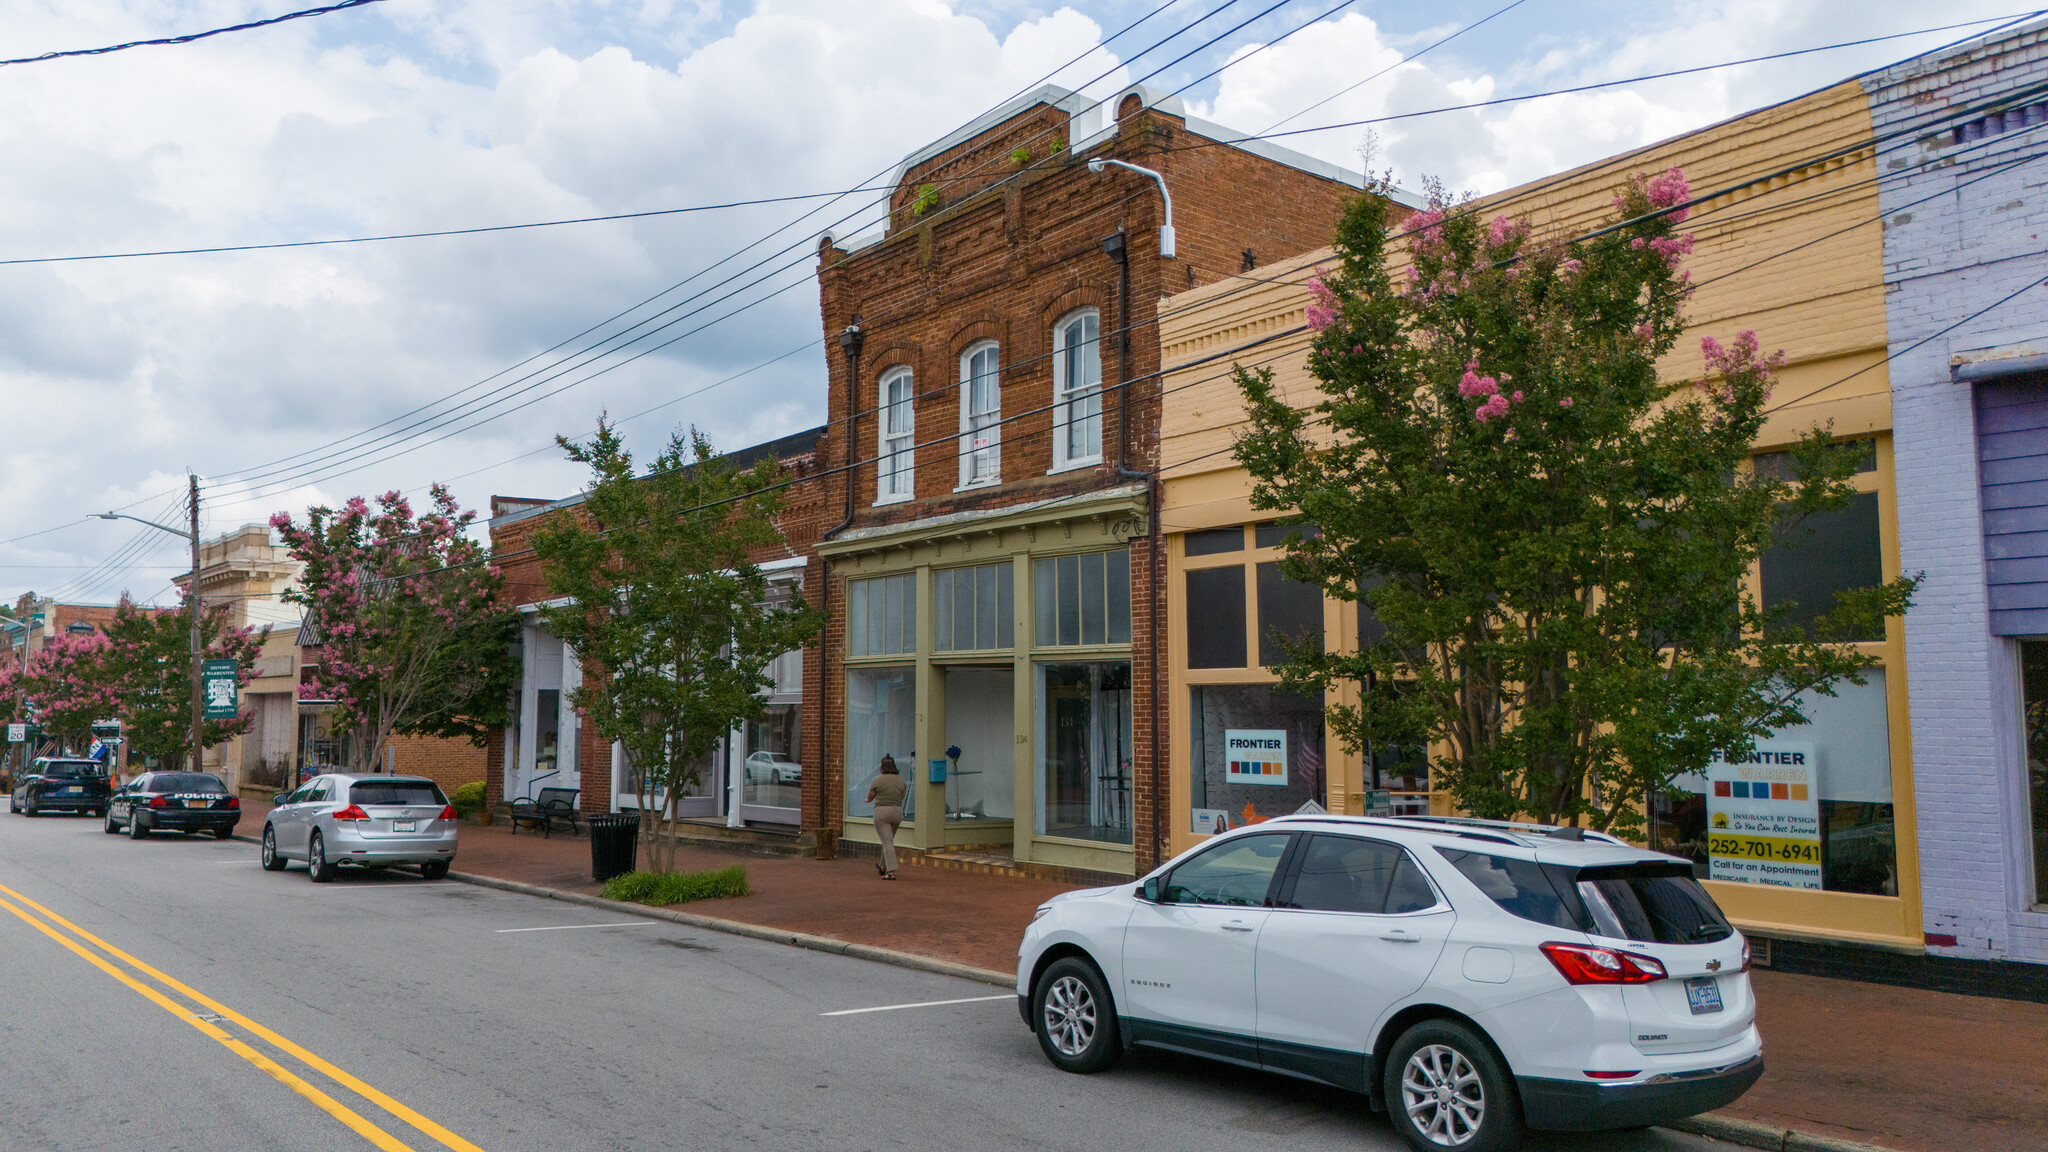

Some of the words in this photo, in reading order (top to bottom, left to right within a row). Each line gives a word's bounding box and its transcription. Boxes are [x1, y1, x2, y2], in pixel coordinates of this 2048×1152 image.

[1016, 734, 1028, 744] 134
[1230, 739, 1281, 749] FRONTIER
[1738, 767, 1807, 781] WARREN
[1733, 813, 1775, 822] INSURANCE
[1787, 816, 1816, 824] DESIGN
[1734, 822, 1742, 830] So
[1745, 823, 1756, 831] You
[1757, 824, 1771, 832] Can
[1772, 825, 1788, 833] Rest
[1790, 826, 1817, 835] Insured
[1710, 839, 1819, 861] 252-701-6941
[1713, 860, 1731, 869] Call
[1732, 861, 1743, 870] for
[1760, 864, 1819, 877] Appointment
[1713, 874, 1749, 883] MEDICARE
[1760, 878, 1792, 887] MEDICAL
[1131, 979, 1171, 988] EQUINOX
